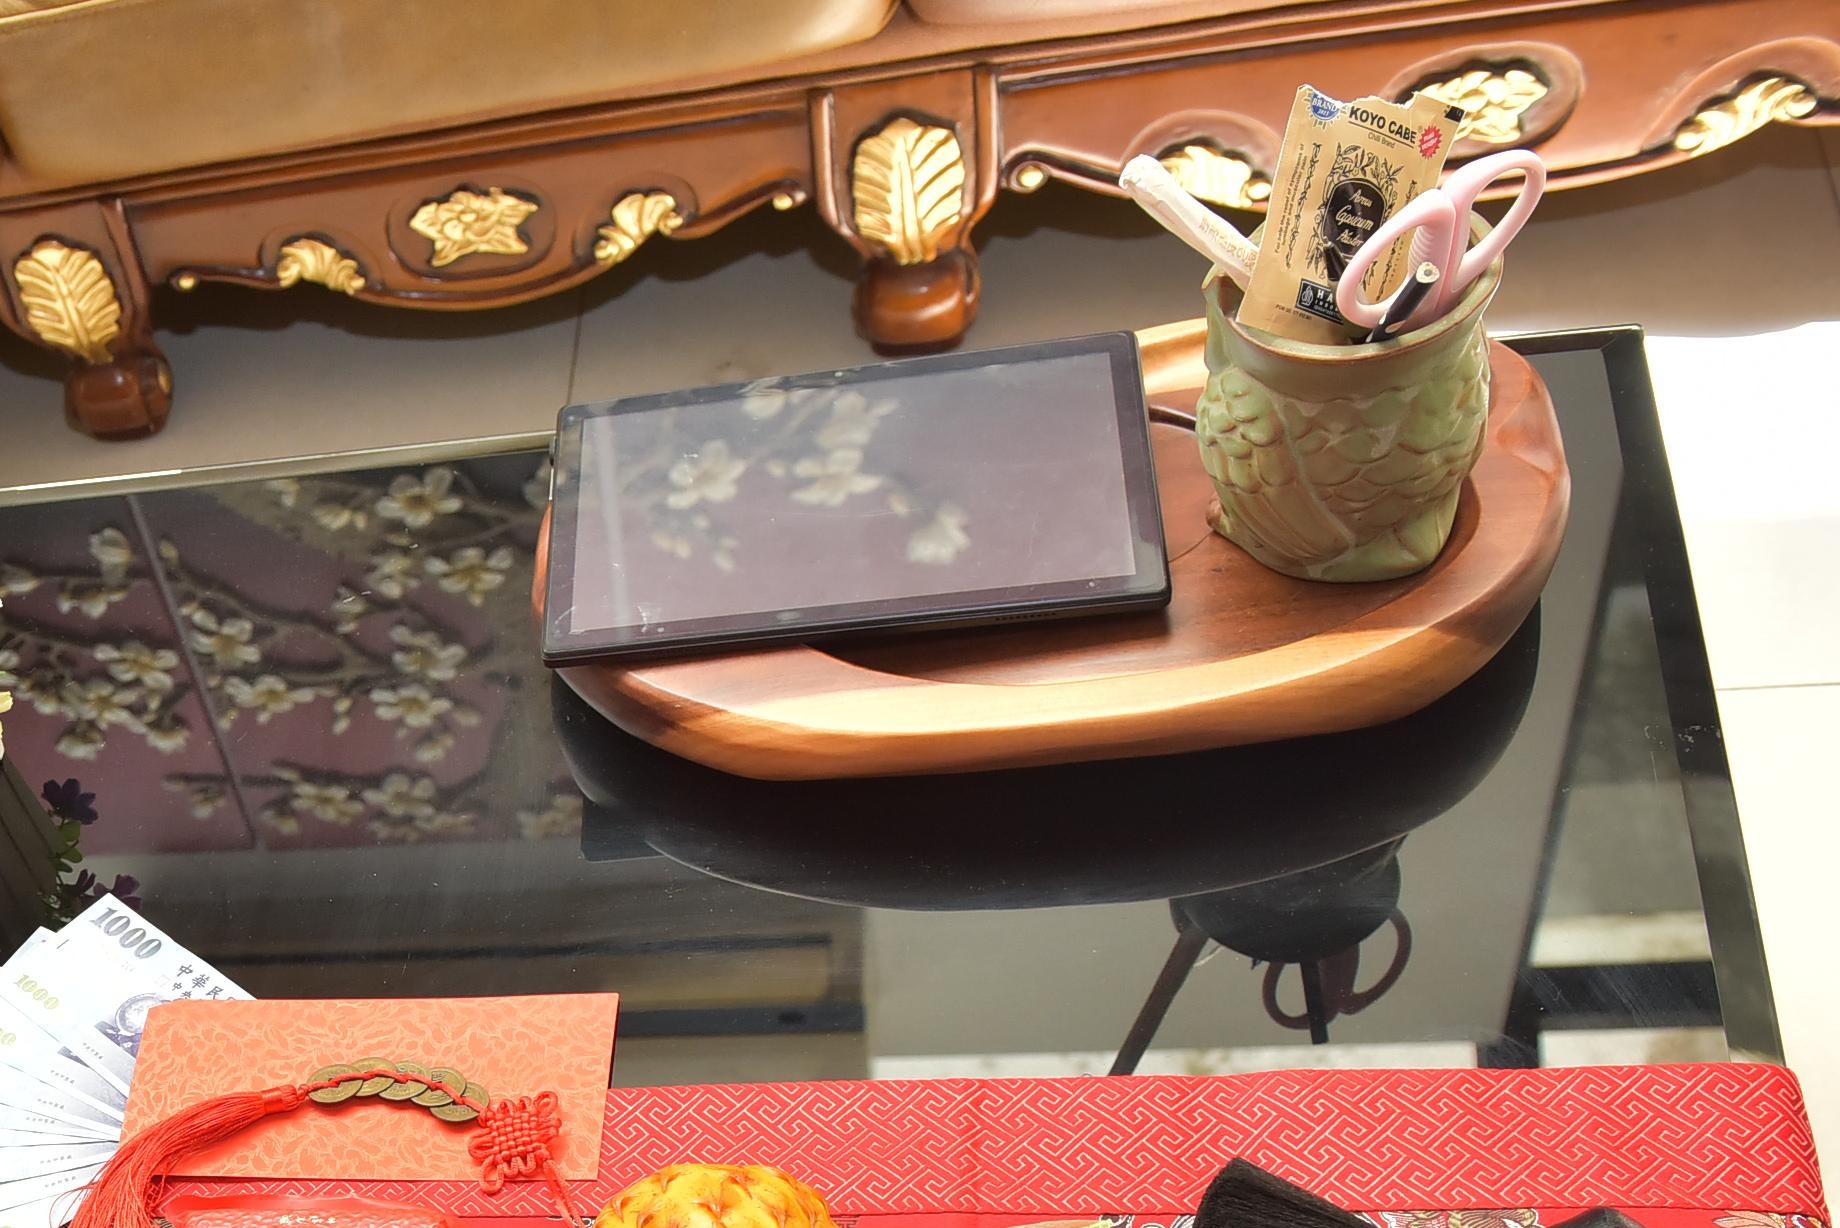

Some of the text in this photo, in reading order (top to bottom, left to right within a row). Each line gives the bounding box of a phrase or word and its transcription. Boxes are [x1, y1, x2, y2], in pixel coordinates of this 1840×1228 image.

[1312, 98, 1337, 111] BRAND
[1349, 106, 1386, 129] KOYO
[1388, 121, 1417, 144] CABE
[1336, 204, 1374, 231] Capsicum
[89, 907, 162, 959] 1000
[14, 974, 60, 1010] 1000
[177, 964, 236, 1000] 中華民
